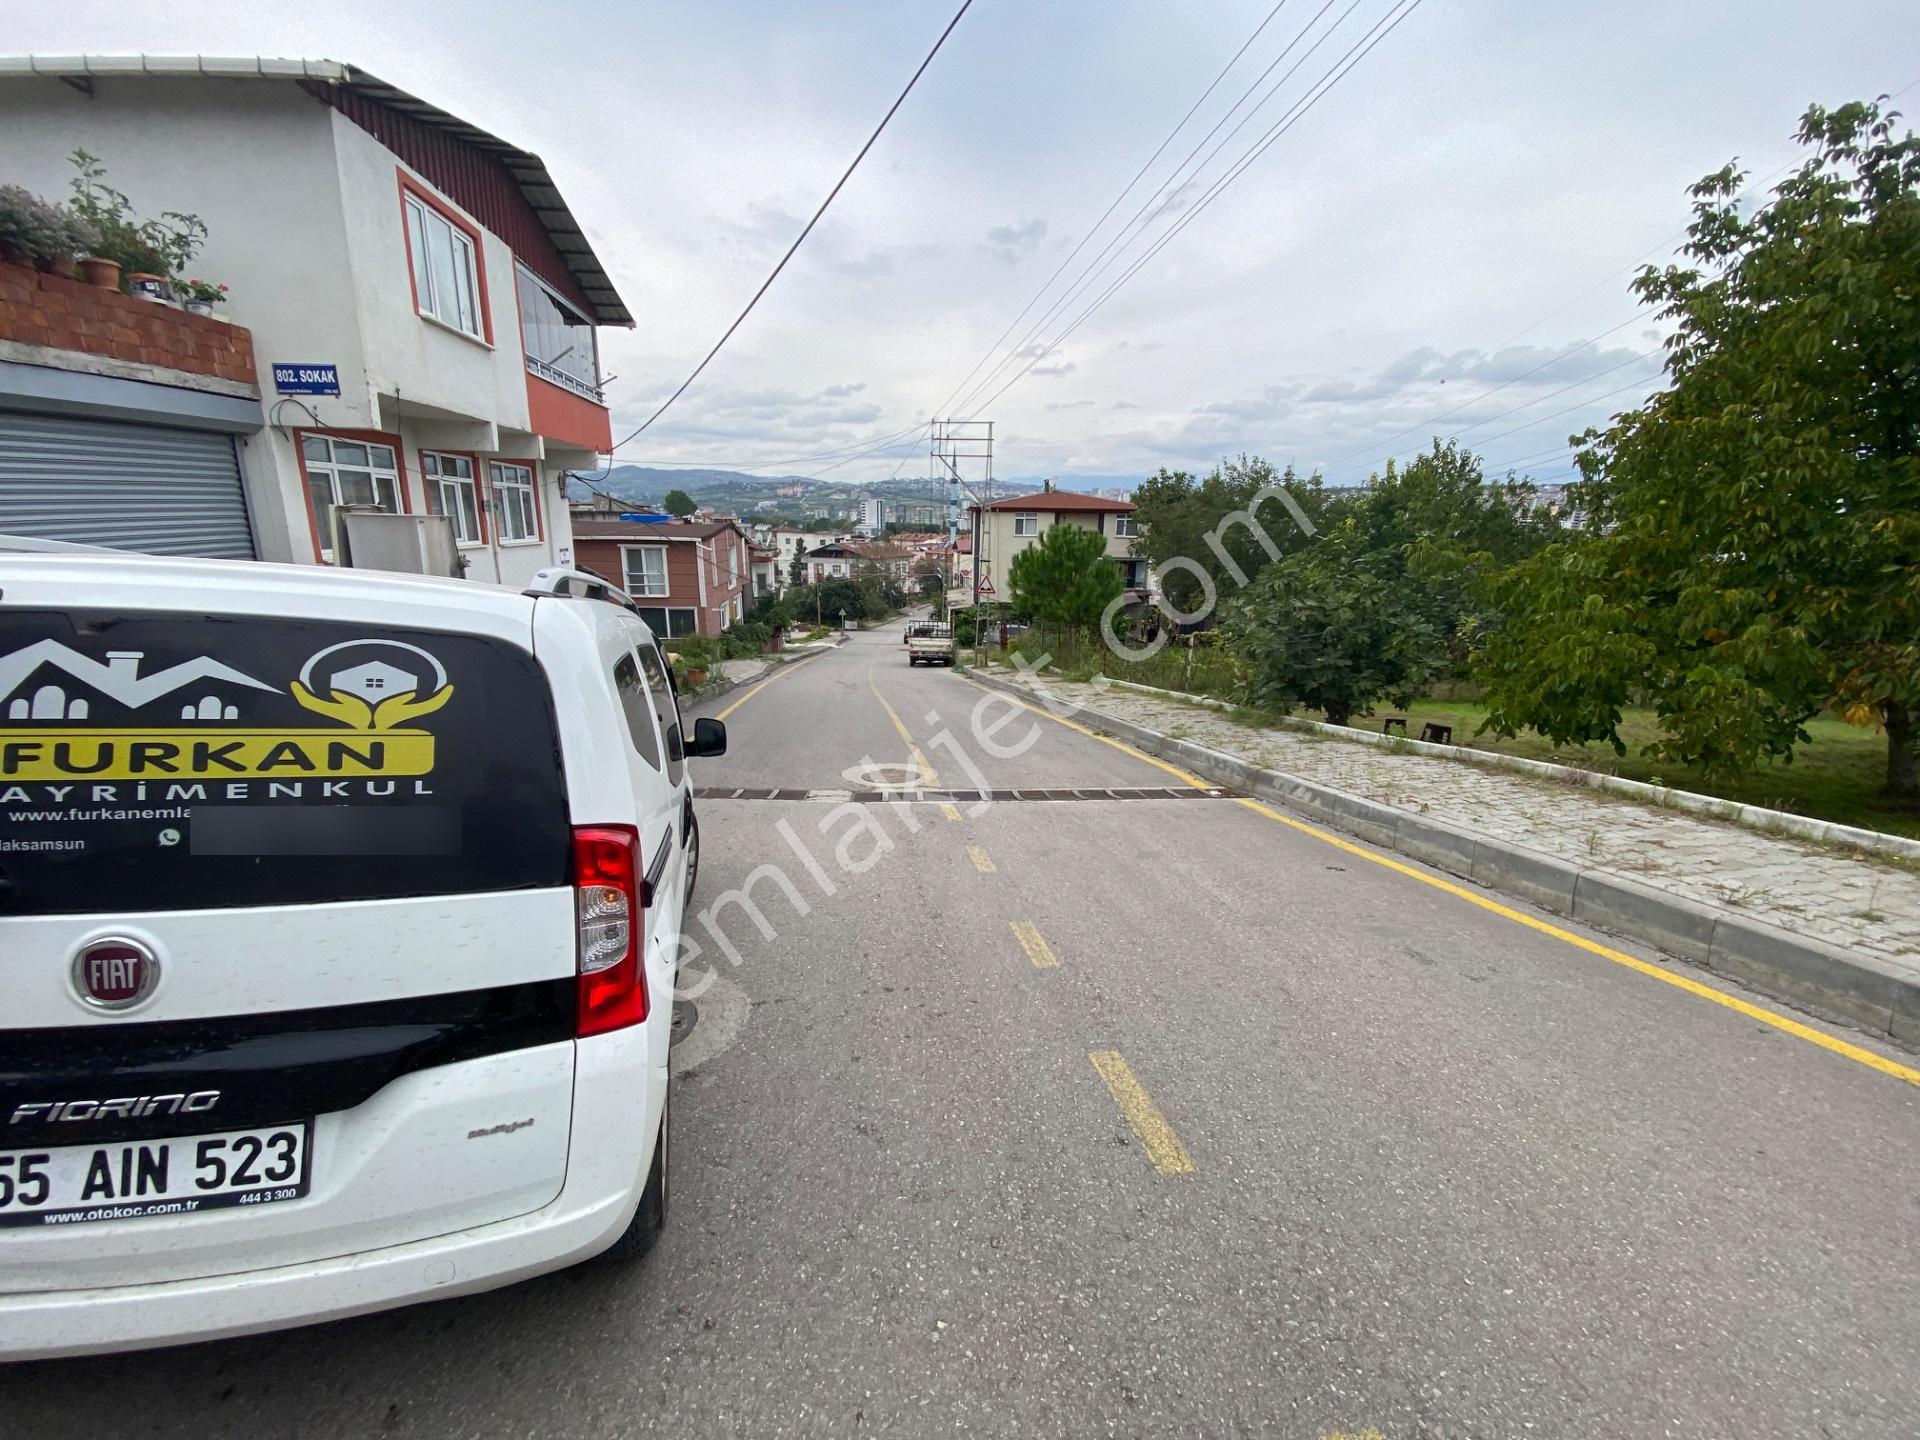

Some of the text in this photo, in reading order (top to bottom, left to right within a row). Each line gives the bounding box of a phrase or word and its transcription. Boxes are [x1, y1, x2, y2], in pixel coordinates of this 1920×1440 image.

[276, 369, 336, 383] 802. SOKAK
[2, 741, 385, 775] FURKAN
[90, 958, 139, 991] FIAT
[9, 1090, 221, 1125] FIORINO
[81, 1144, 170, 1200] AIN
[195, 1131, 298, 1190] 523
[44, 1198, 200, 1225] www.otokoc.com.tr
[239, 1187, 297, 1205] 444 3 300
